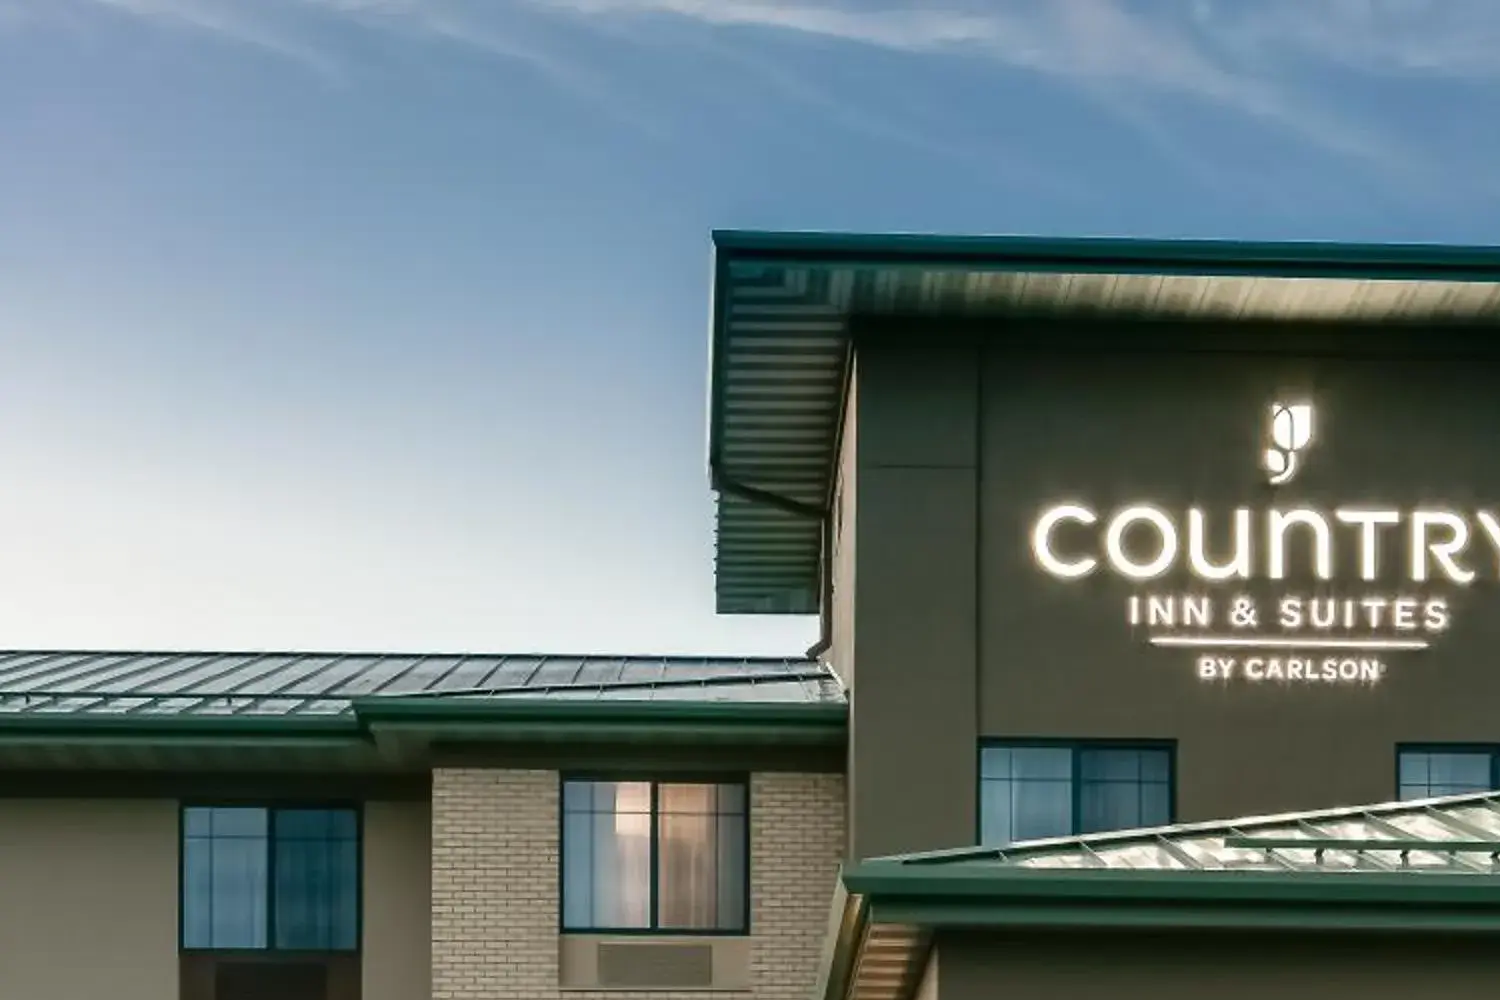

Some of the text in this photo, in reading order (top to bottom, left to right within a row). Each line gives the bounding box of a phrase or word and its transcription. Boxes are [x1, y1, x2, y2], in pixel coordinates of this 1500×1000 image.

[1130, 596, 1449, 629] INN & SUITES
[1199, 658, 1379, 681] BY CARLSON
